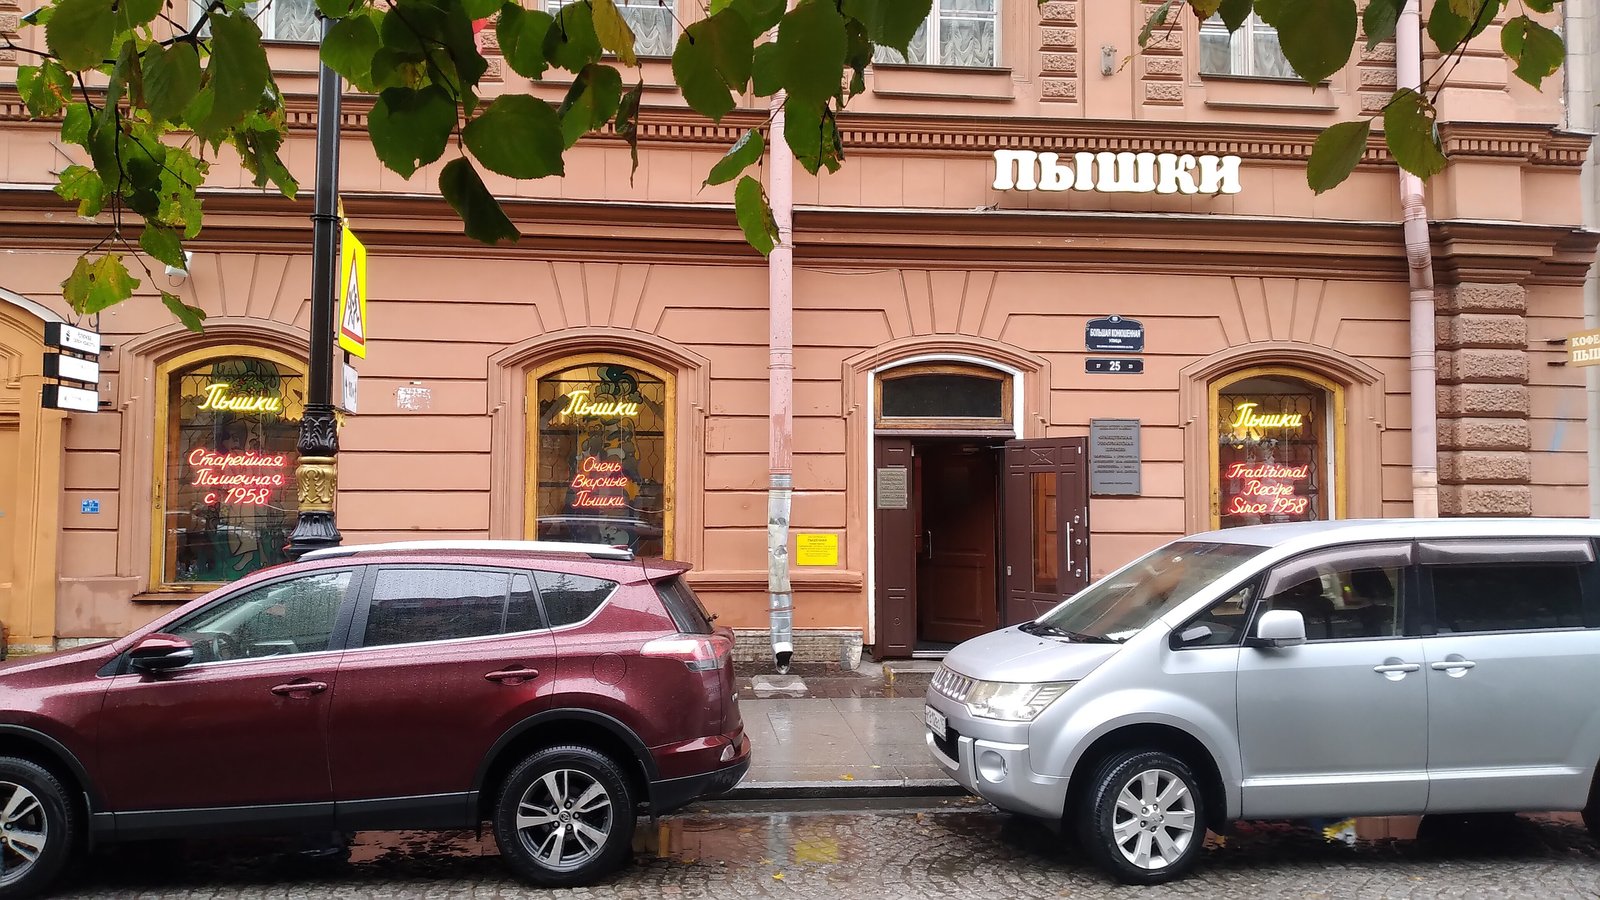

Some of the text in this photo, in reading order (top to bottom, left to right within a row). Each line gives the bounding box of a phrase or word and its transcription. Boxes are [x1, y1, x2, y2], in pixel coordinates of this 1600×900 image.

[992, 149, 1242, 194] ПЫШКИ
[1572, 334, 1600, 347] КОФЕ
[1109, 360, 1121, 371] 25
[197, 383, 280, 411] Пышки
[560, 390, 638, 415] Пышки
[1232, 403, 1303, 428] Пышки
[189, 448, 284, 470] Старейшая
[583, 456, 622, 472] Очень
[191, 468, 283, 486] Пышечная
[1229, 463, 1308, 478] Traditional
[571, 474, 628, 489] Вкусные
[224, 488, 269, 505] 1958
[572, 490, 624, 507] Пышки
[1243, 480, 1294, 501] Recipe
[1230, 497, 1308, 514] Since 1958
